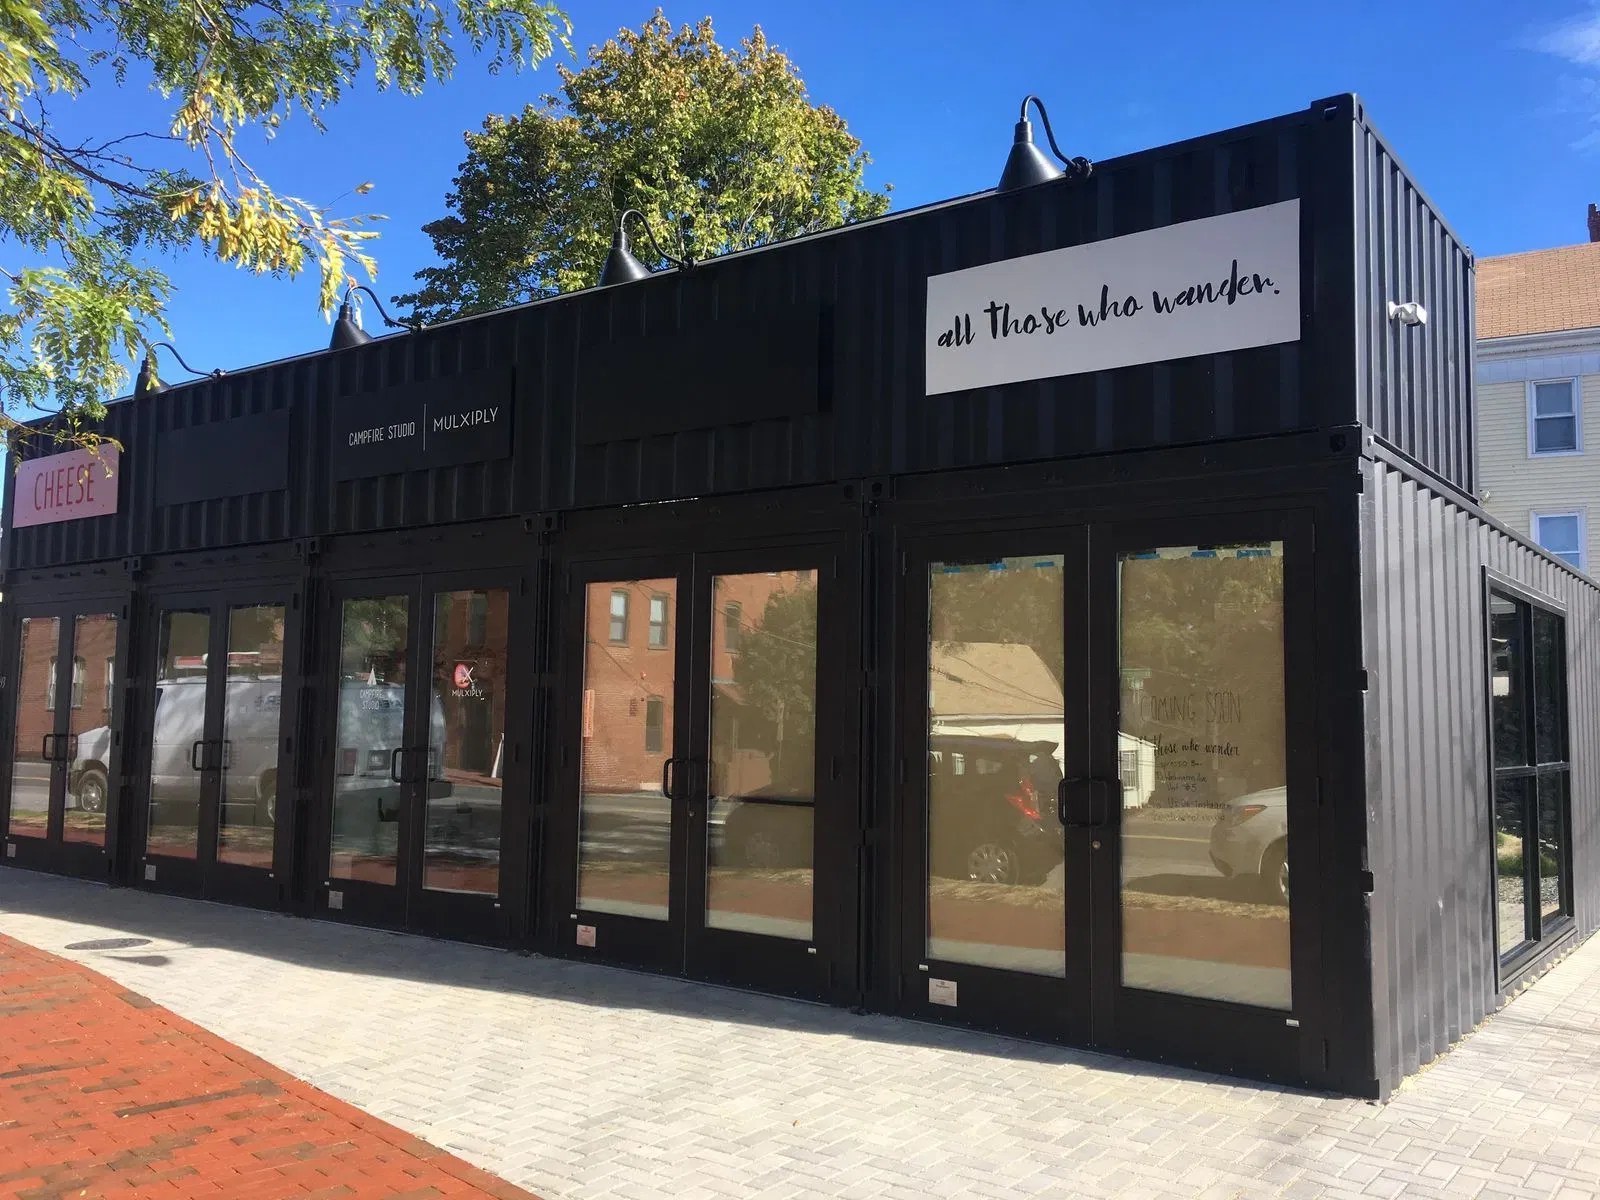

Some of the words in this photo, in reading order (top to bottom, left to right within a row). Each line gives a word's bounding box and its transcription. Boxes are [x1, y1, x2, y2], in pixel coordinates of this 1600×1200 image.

[937, 313, 975, 347] all
[1077, 284, 1143, 326] who
[1152, 259, 1280, 313] wander.
[348, 427, 384, 446] CAMPFIRE
[388, 421, 416, 440] STUDIO
[433, 406, 499, 432] MULXIPLY
[34, 462, 95, 511] CHEESE
[451, 689, 483, 697] MULXIPLY
[1205, 687, 1241, 723] SOON
